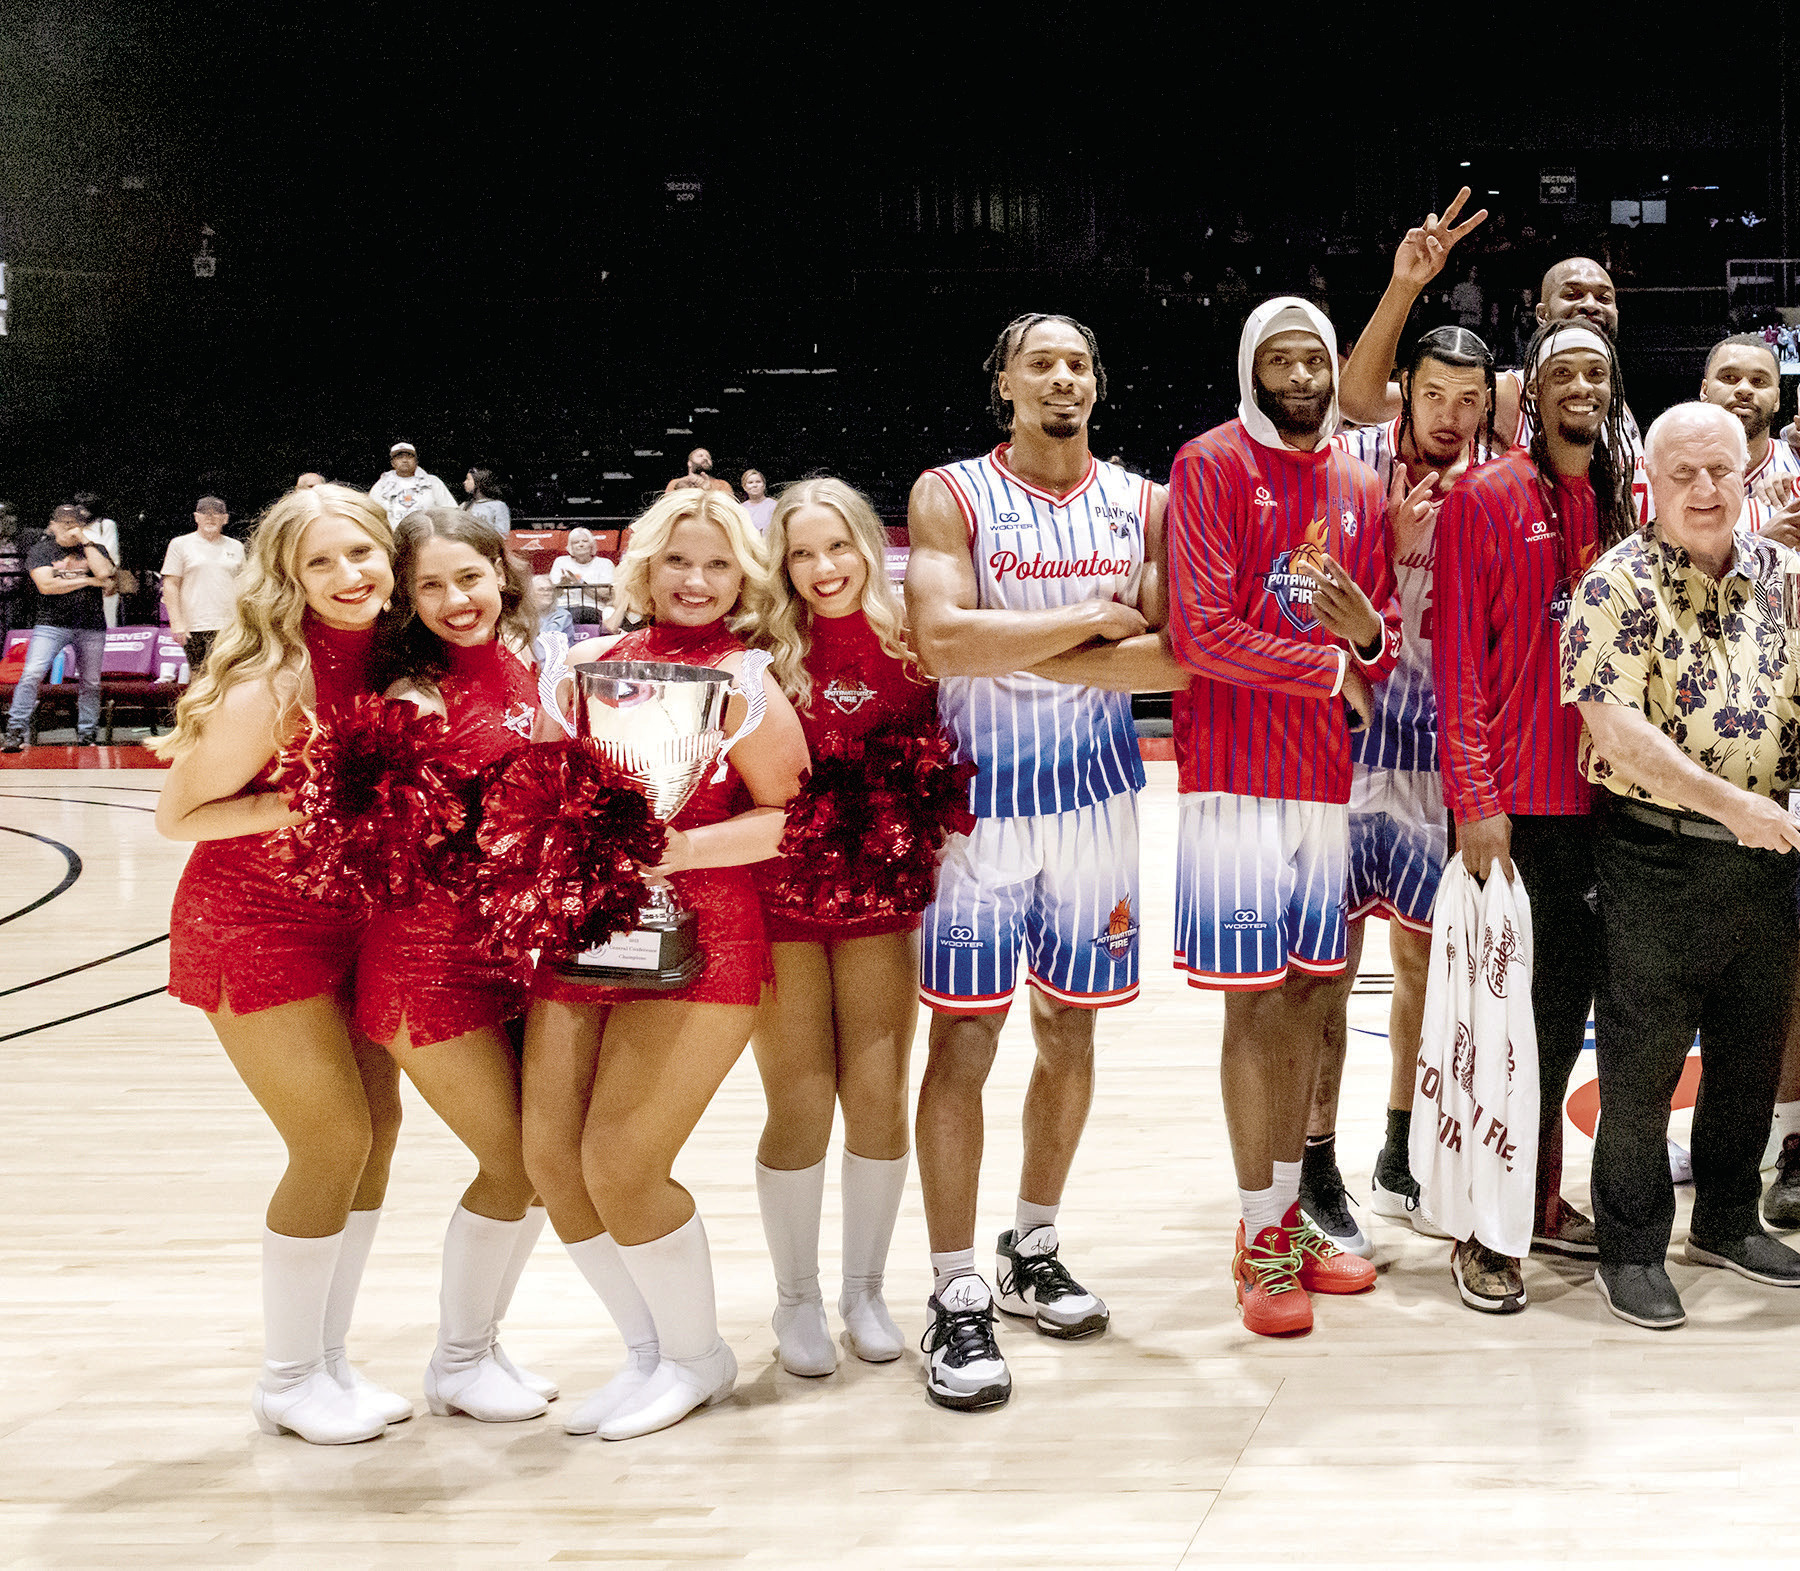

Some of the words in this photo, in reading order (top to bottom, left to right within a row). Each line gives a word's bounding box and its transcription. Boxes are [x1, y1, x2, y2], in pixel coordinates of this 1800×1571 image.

[989, 523, 1034, 532] WOOTER
[1525, 531, 1557, 543] WOOTER
[1289, 587, 1313, 605] FIR
[1224, 922, 1268, 930] WOOTER
[940, 939, 984, 949] WOOTER
[1109, 939, 1129, 951] FIRE
